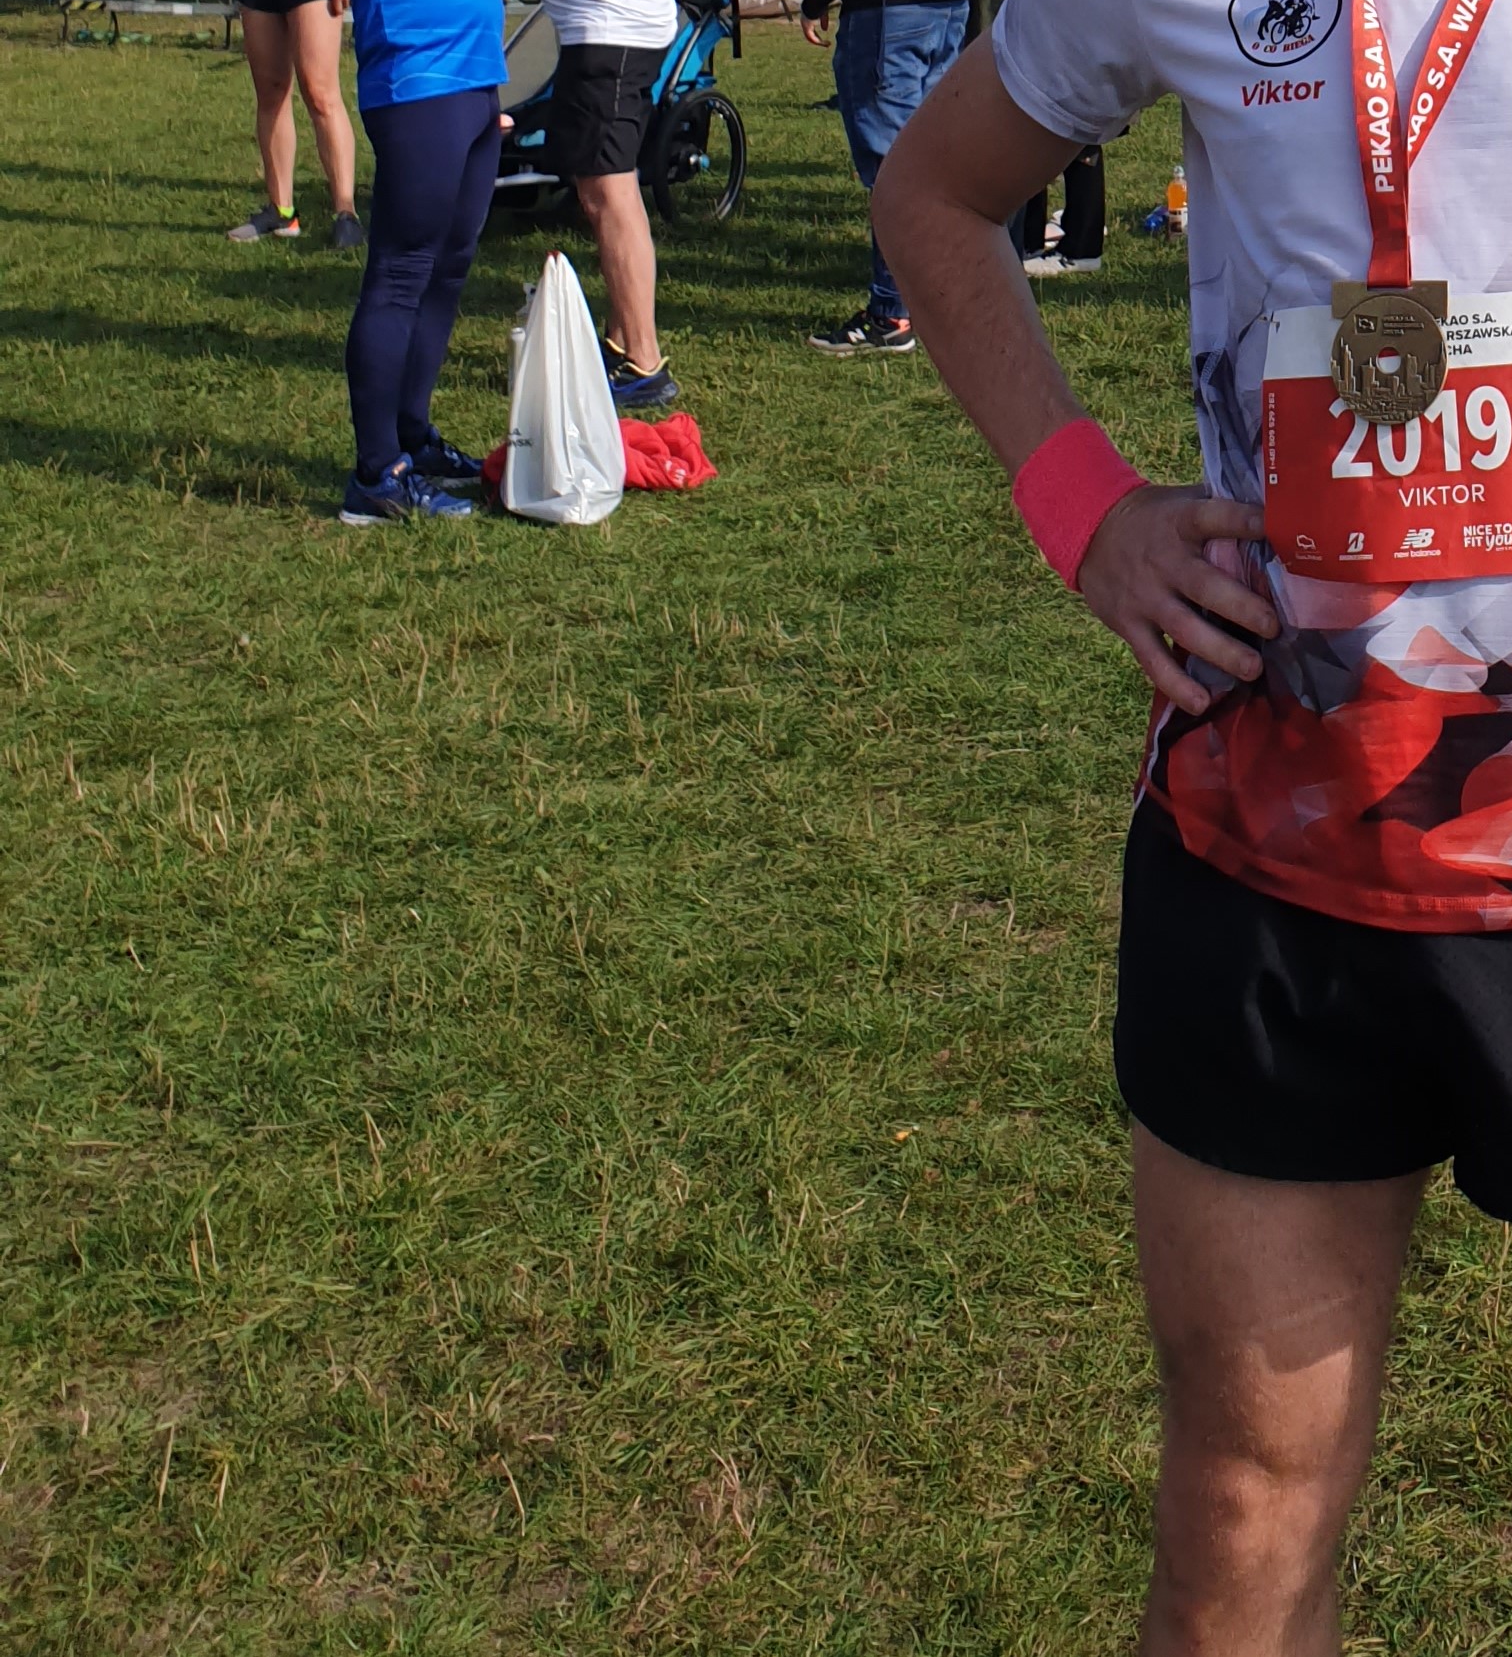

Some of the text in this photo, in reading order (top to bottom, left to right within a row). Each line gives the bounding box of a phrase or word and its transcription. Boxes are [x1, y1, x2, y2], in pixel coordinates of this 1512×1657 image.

[1364, 38, 1387, 90] S.A.
[1427, 40, 1463, 91] S.A.
[1241, 79, 1326, 107] Viktor
[1367, 96, 1395, 193] PEKAO
[1472, 312, 1497, 325] S.A.
[1398, 483, 1486, 509] VIKTOR
[1463, 522, 1512, 537] NICE TO
[1463, 536, 1484, 548] FIT
